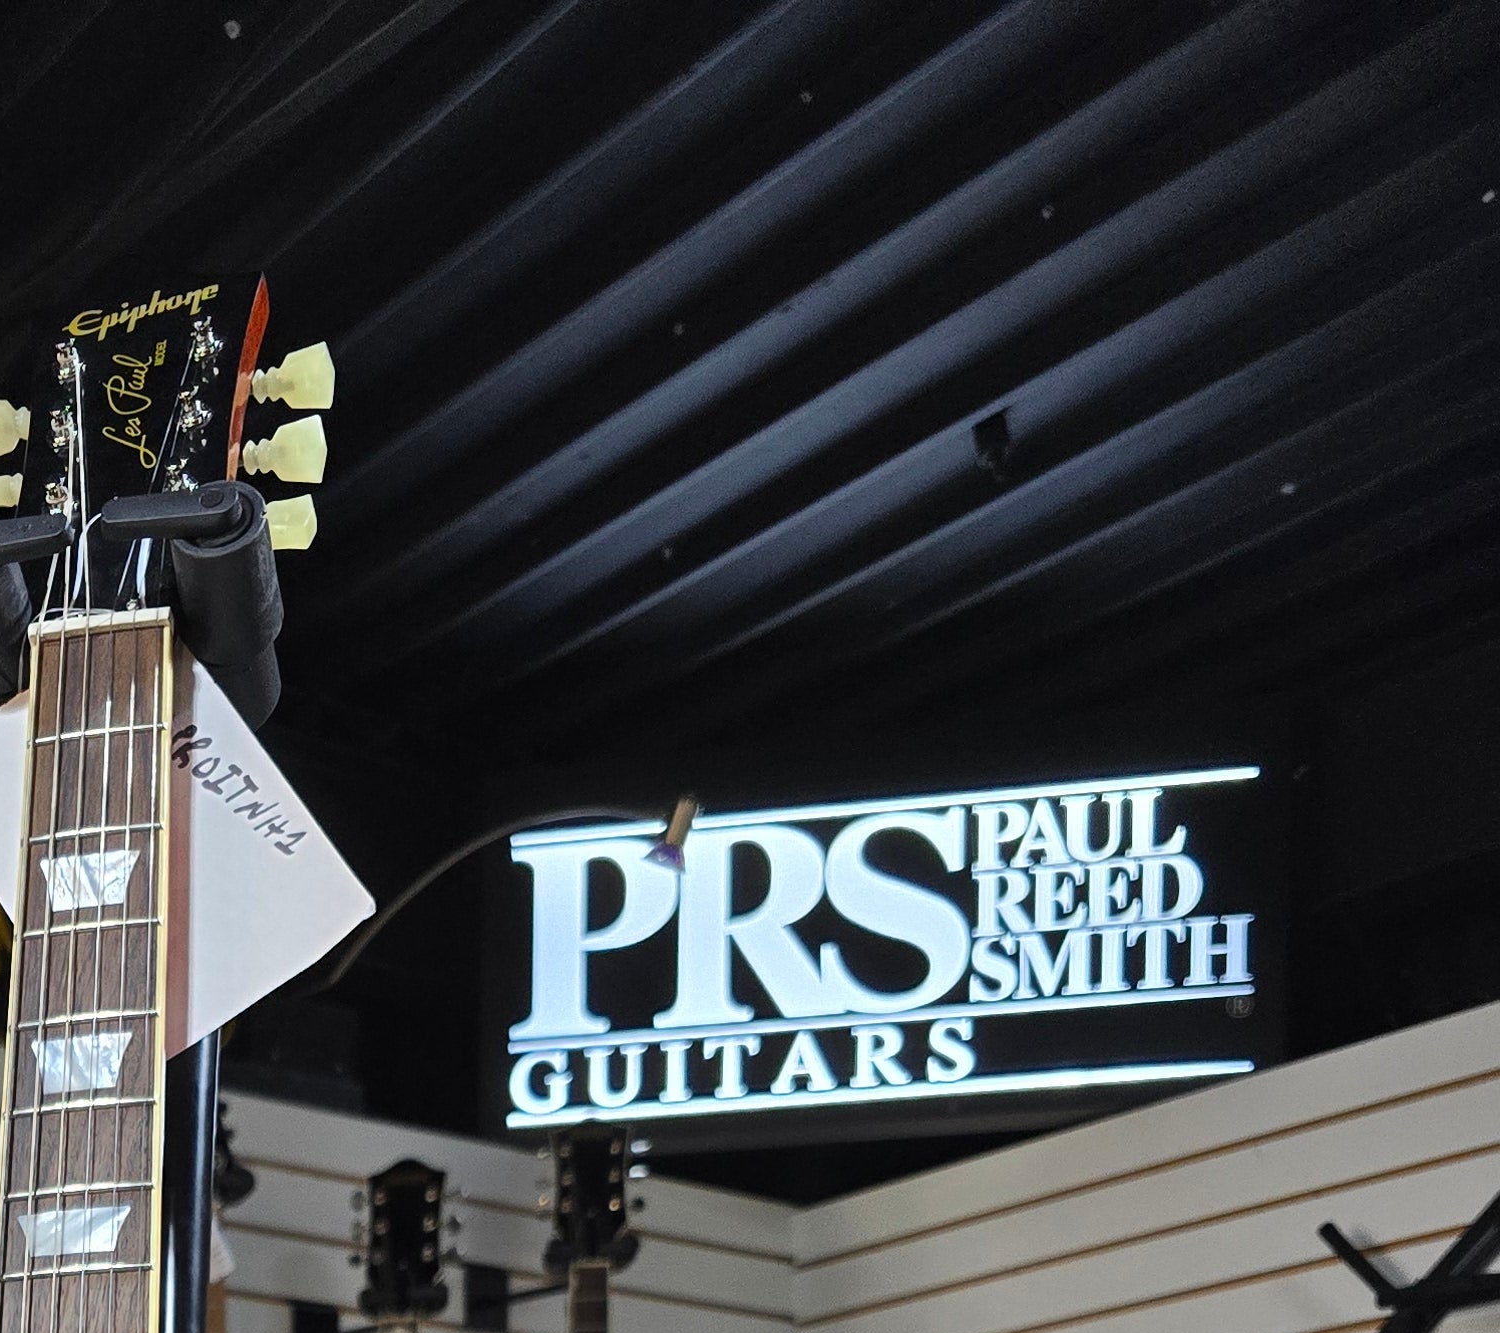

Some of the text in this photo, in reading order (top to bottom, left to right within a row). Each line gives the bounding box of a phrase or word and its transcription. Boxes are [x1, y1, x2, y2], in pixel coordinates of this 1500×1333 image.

[61, 284, 219, 341] Epiphone
[102, 354, 157, 469] Les Paul
[971, 787, 1188, 872] PAUL
[509, 806, 970, 1038] PRS
[971, 853, 1204, 936] REED
[969, 913, 1256, 1002] SMITH
[509, 1018, 977, 1115] GUITARS
